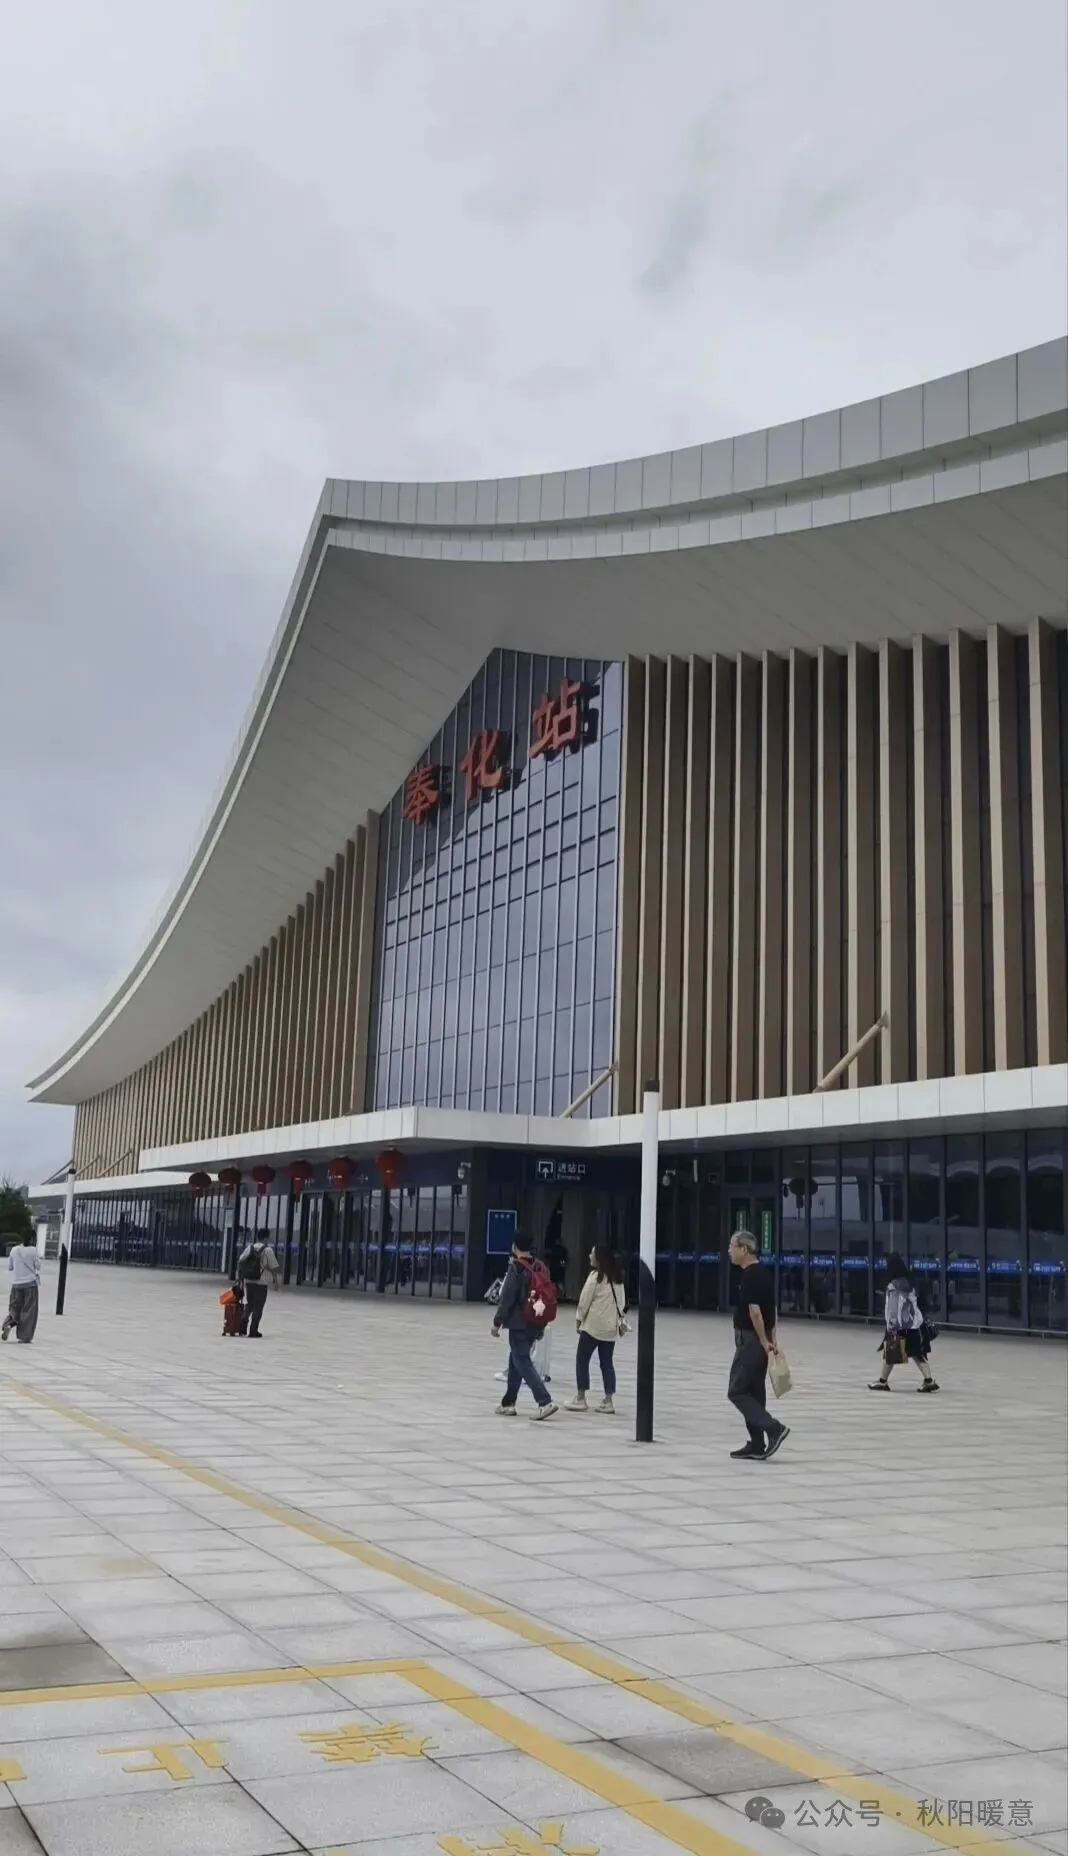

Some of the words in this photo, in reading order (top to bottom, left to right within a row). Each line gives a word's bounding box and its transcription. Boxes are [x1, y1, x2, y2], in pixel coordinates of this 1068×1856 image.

[402, 679, 582, 825] 奉化站
[0, 1723, 440, 1781] 禁止
